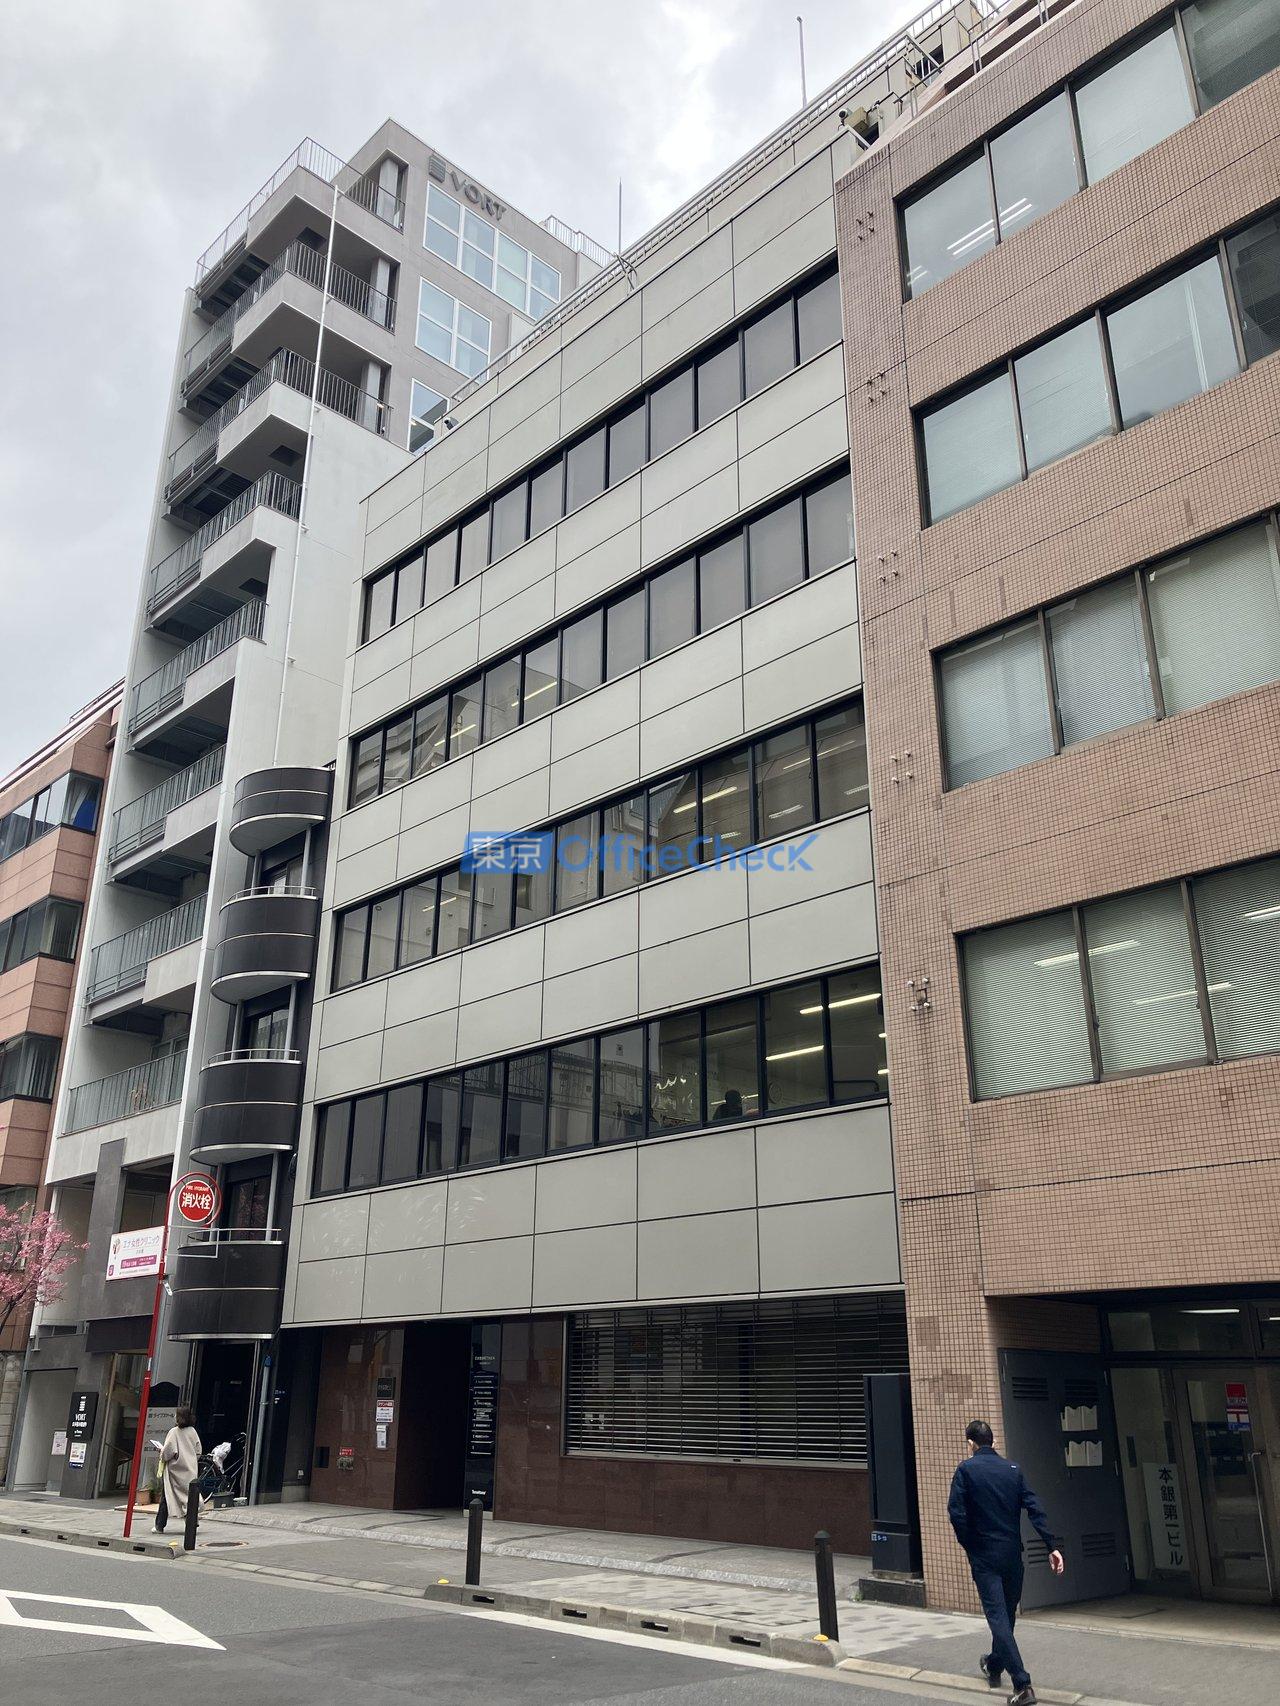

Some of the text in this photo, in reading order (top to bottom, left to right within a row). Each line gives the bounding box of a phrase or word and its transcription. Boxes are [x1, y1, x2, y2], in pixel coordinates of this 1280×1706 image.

[449, 170, 507, 221] VORT
[181, 1192, 212, 1210] 消火栓
[1158, 1467, 1184, 1566] 本銀第一ビル
